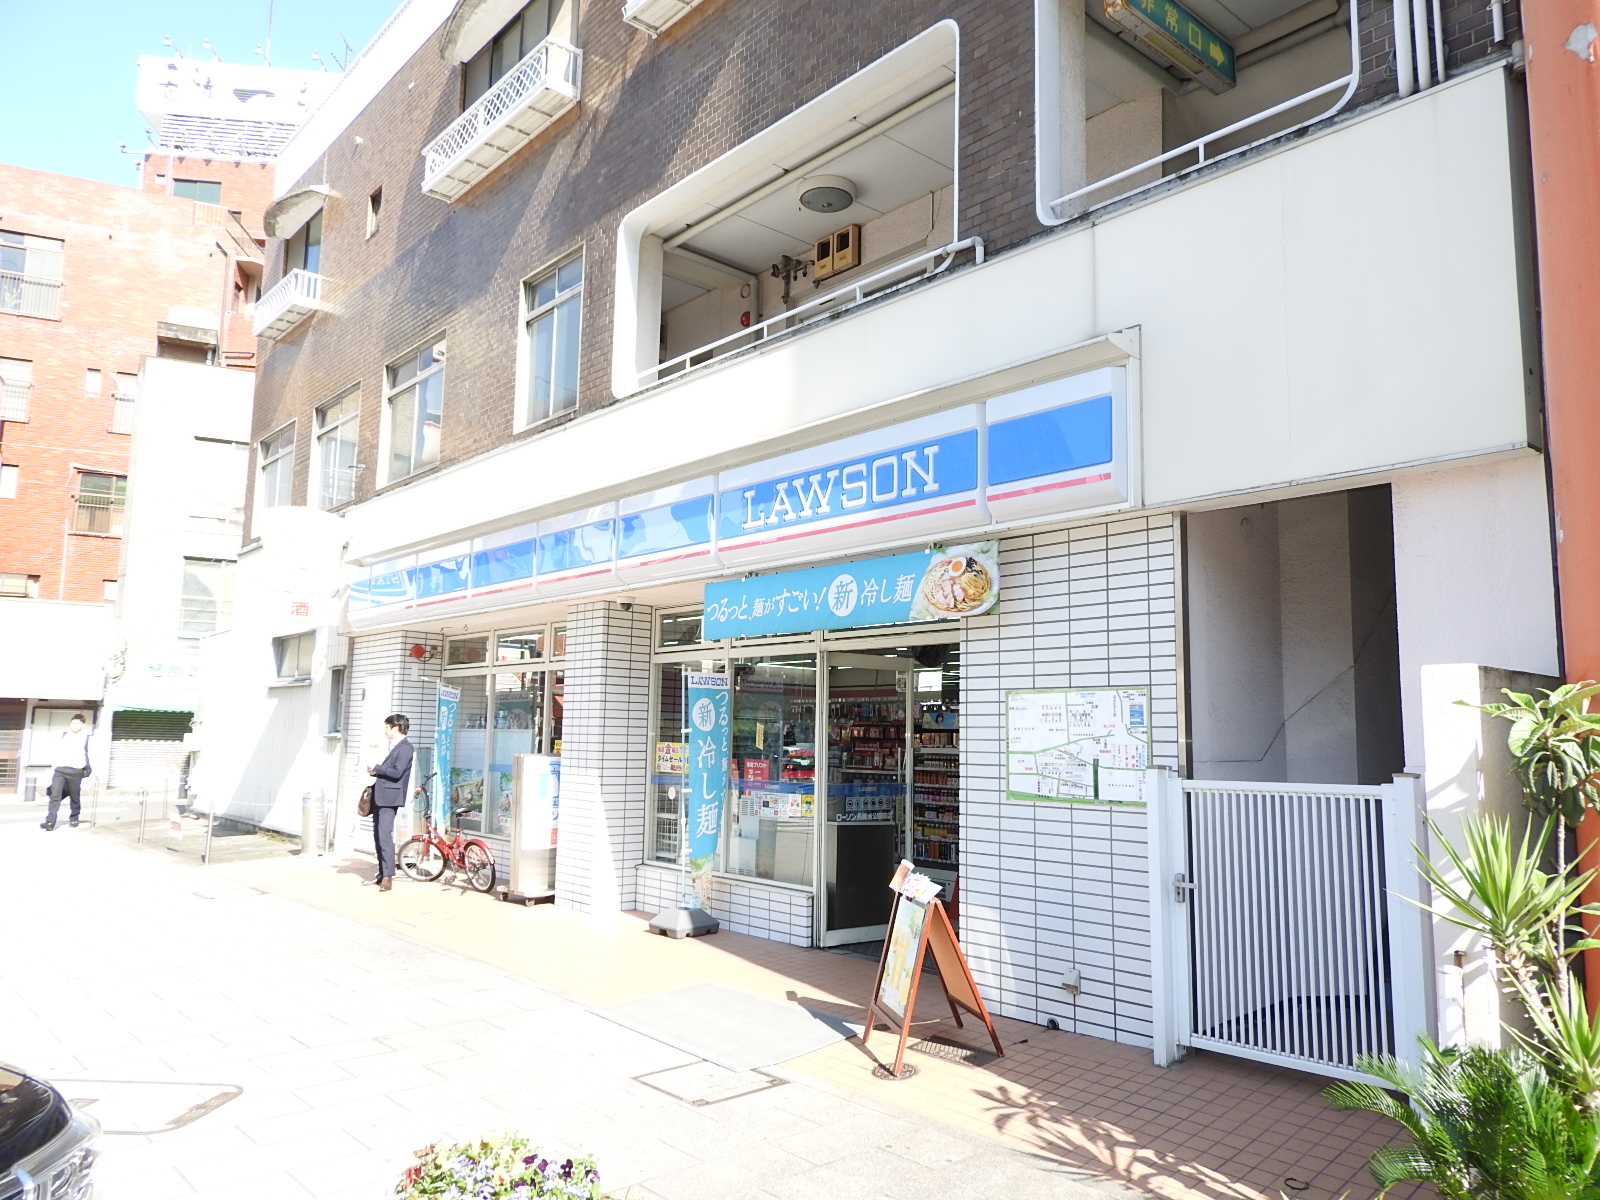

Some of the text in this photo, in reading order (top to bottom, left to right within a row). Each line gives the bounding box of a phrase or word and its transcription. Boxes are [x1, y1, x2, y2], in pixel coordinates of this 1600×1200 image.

[742, 444, 939, 531] LAWSON
[291, 601, 310, 617] 酒
[832, 580, 855, 611] 新
[860, 573, 916, 608] 冷し麺
[690, 675, 729, 687] LAWSON
[696, 735, 719, 838] 冷し麺
